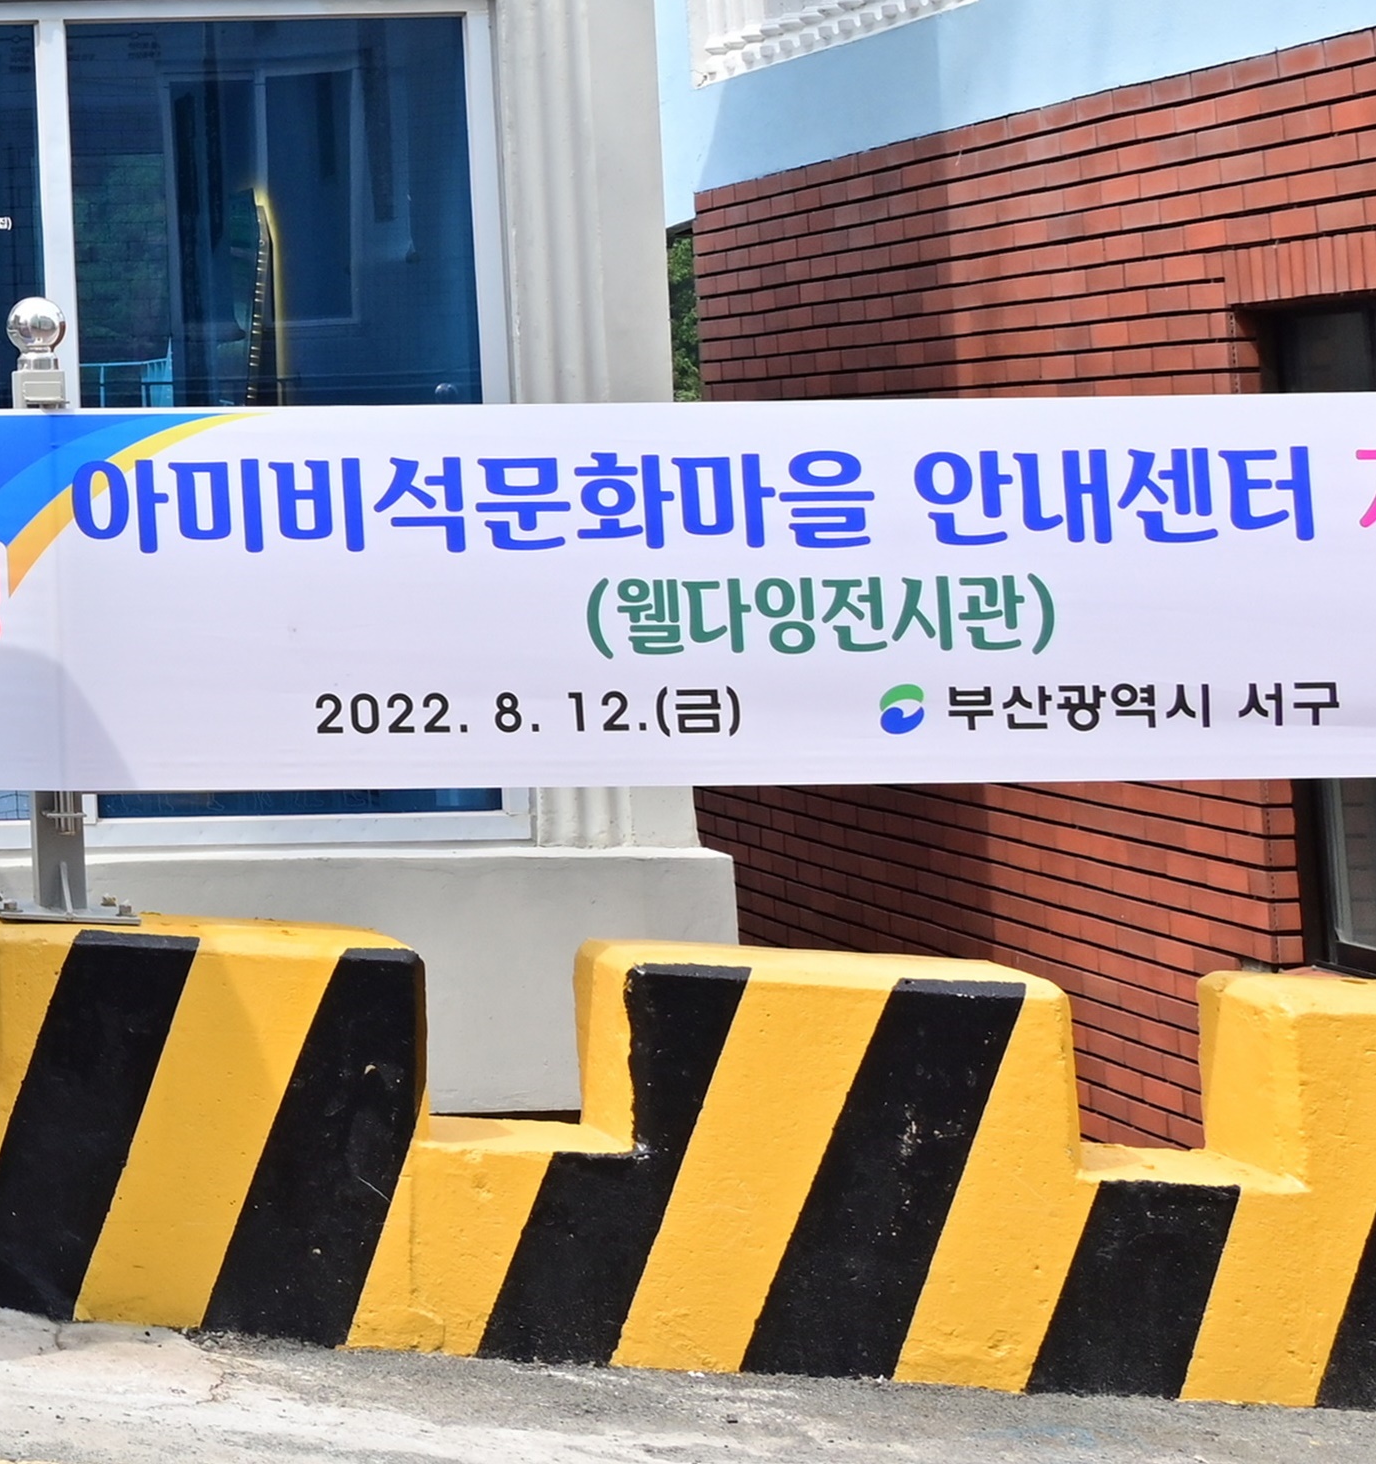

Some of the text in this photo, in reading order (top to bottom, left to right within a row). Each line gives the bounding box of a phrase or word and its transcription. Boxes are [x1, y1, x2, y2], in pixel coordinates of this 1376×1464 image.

[69, 448, 876, 555] 아미비석문화마을
[913, 445, 1315, 545] 안내센터
[585, 571, 1056, 660] (웰다잉전시관)
[315, 685, 742, 736] 2022. 8. 12.(금)
[947, 679, 1342, 731] 부산광역시 서구
